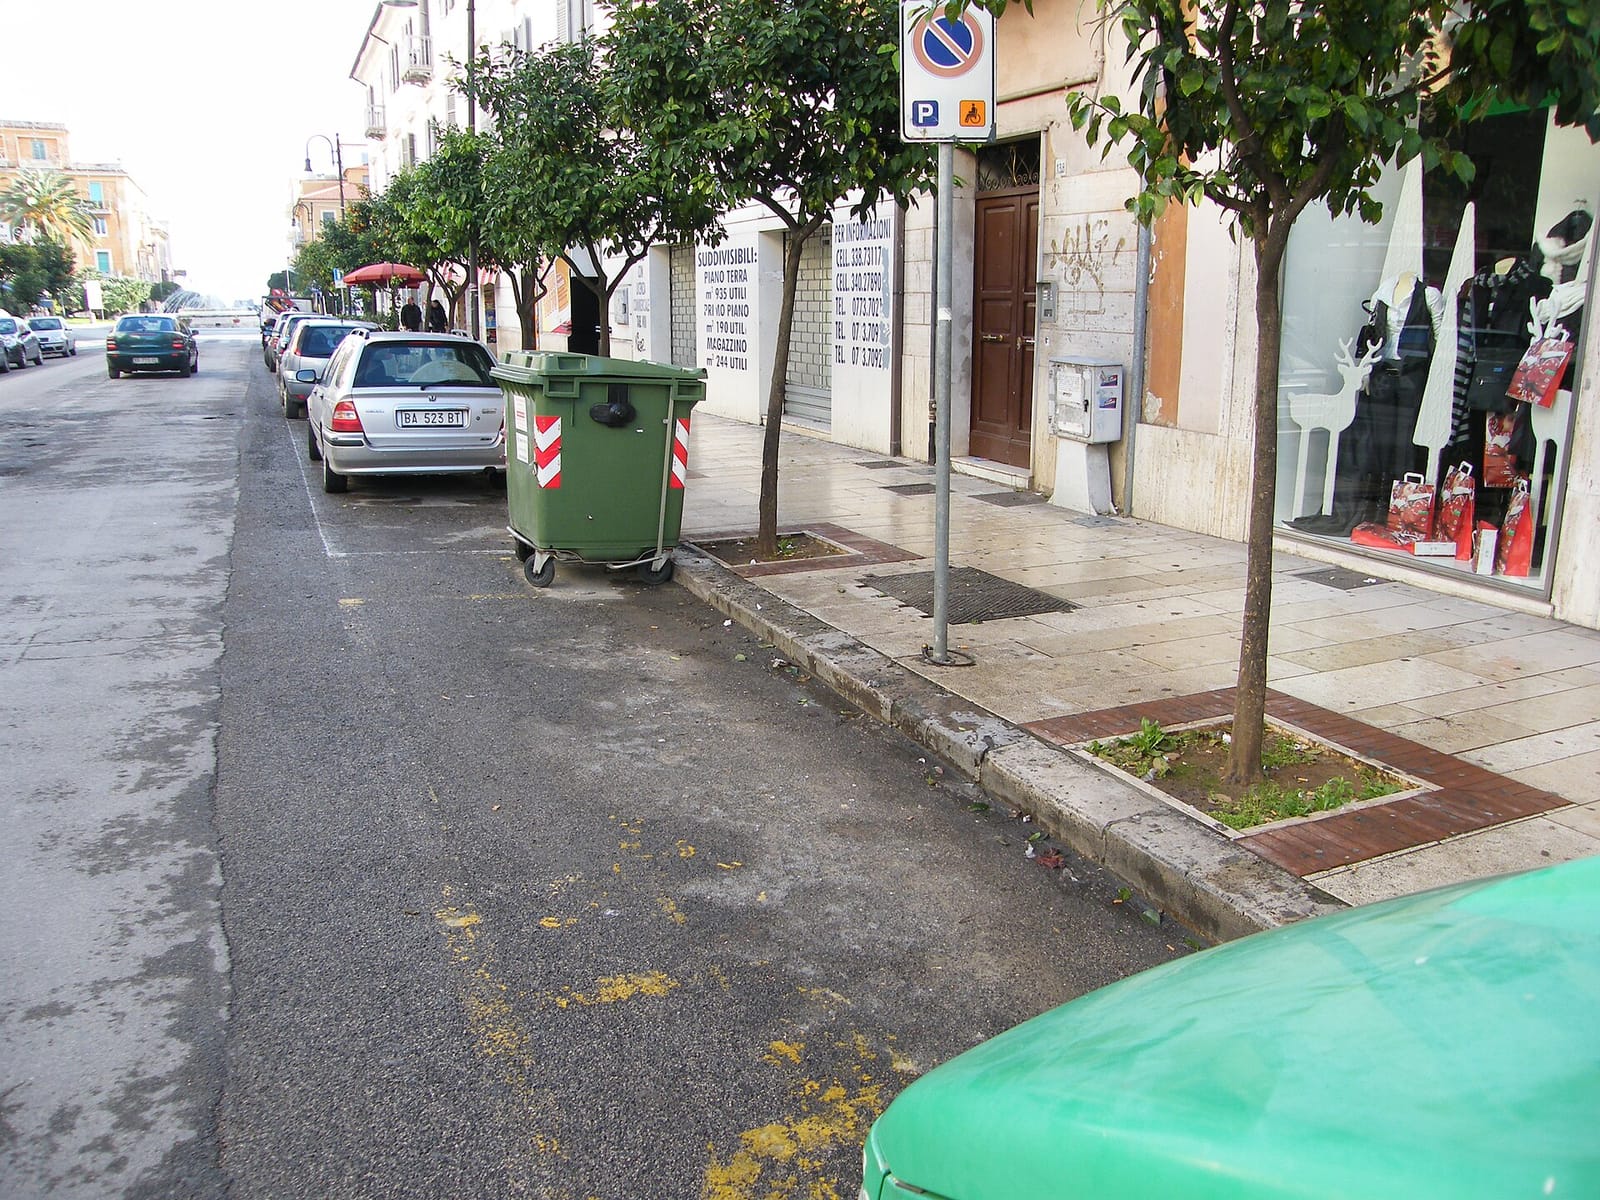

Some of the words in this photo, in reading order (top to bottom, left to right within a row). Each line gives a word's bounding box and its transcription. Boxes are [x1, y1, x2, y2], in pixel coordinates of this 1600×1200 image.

[918, 103, 934, 124] P
[834, 224, 845, 243] PER
[846, 218, 891, 242] INFORMAZIONI
[698, 247, 758, 267] SUDDIVISIBILI:
[836, 248, 850, 267] CELL.
[704, 270, 725, 284] PIANO
[727, 269, 748, 283] TERRA
[836, 273, 850, 291] CELL.
[715, 287, 728, 300] 935
[729, 287, 747, 300] UTILI
[727, 304, 750, 318] PIANO
[835, 297, 846, 316] TEL.
[716, 321, 729, 334] 190
[835, 321, 846, 340] TEL.
[852, 322, 879, 343] 073.709
[706, 337, 748, 353] MAGAZZINO
[715, 355, 728, 368] 244
[729, 357, 748, 371] UTILI
[835, 345, 846, 364] TEL.
[851, 346, 882, 369] 073.7092
[404, 413, 418, 424] BA
[424, 412, 444, 424] 523
[447, 412, 461, 424] BT
